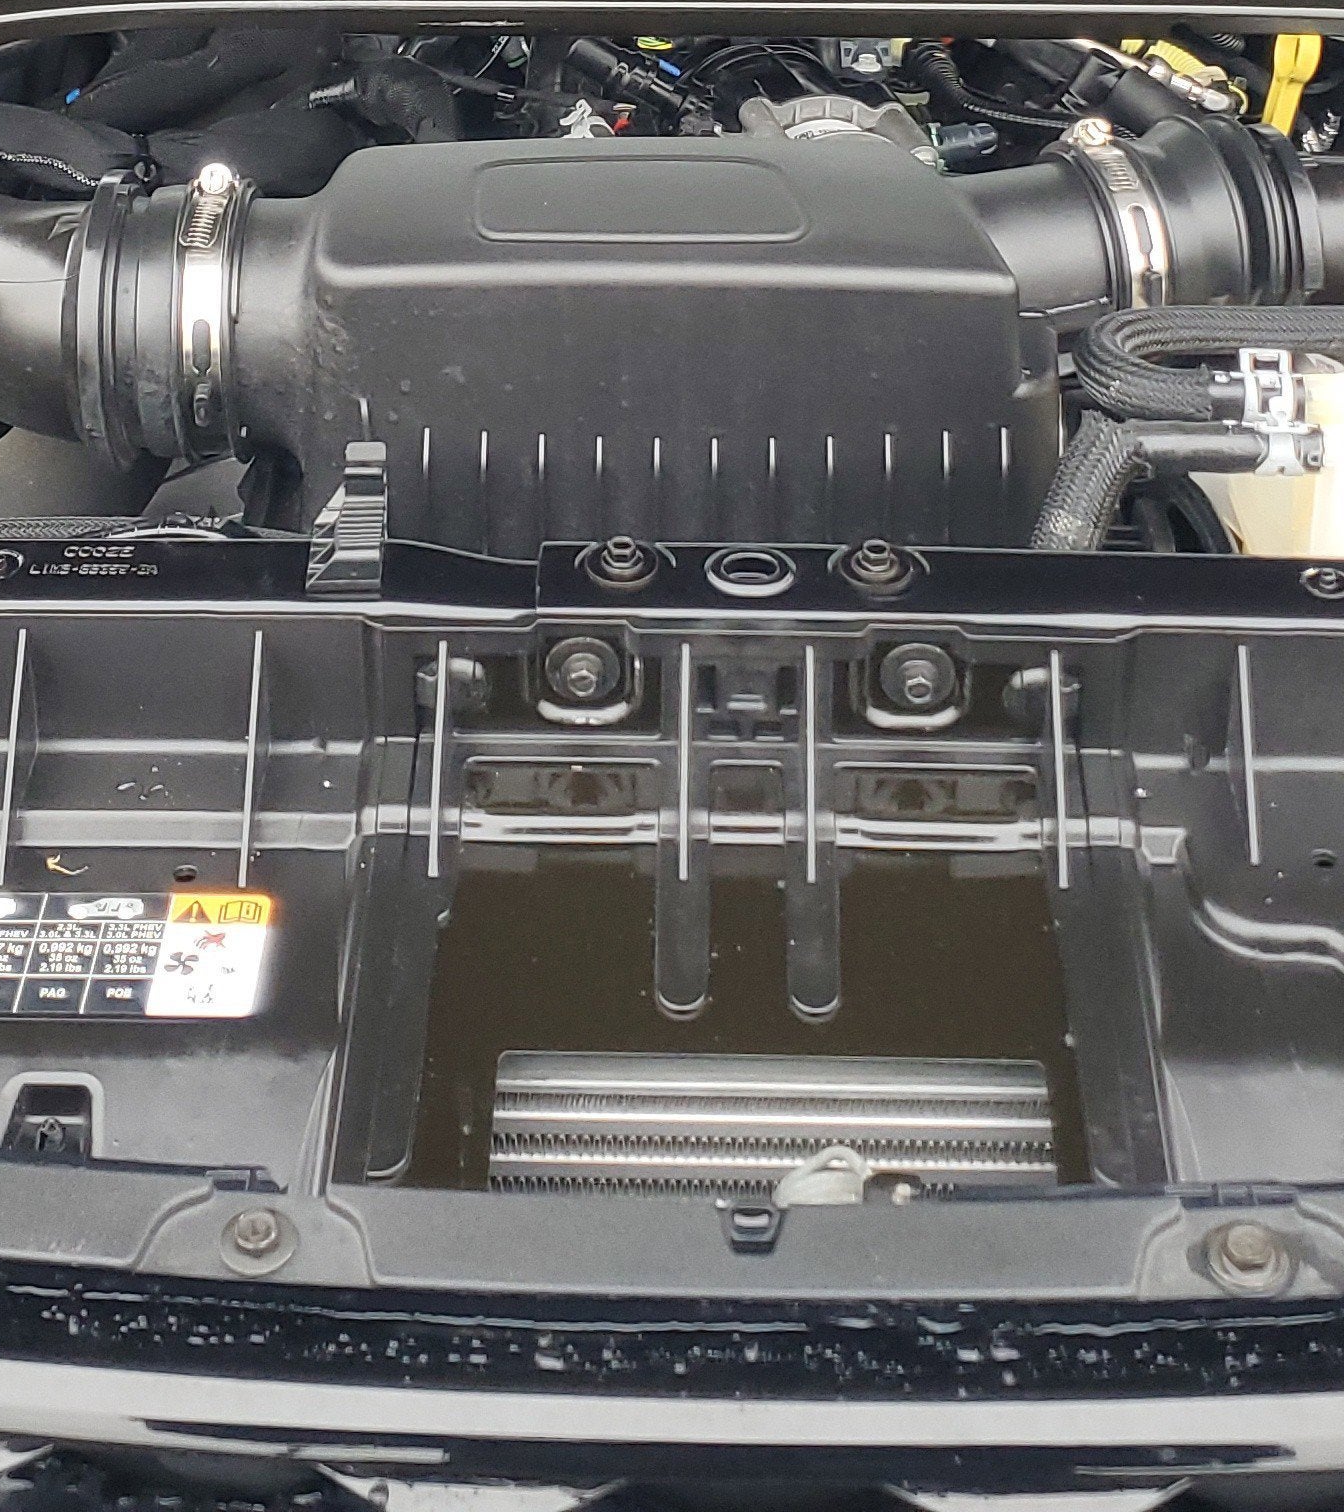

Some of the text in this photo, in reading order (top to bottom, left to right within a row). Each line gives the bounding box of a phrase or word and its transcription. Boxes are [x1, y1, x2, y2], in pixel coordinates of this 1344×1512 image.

[6, 942, 25, 956] kg
[76, 942, 94, 956] kg
[140, 943, 157, 957] kg
[64, 955, 79, 963] oz
[128, 956, 143, 964] oz
[64, 963, 82, 973] lbs
[128, 964, 147, 974] lbs
[38, 987, 66, 999] PAG
